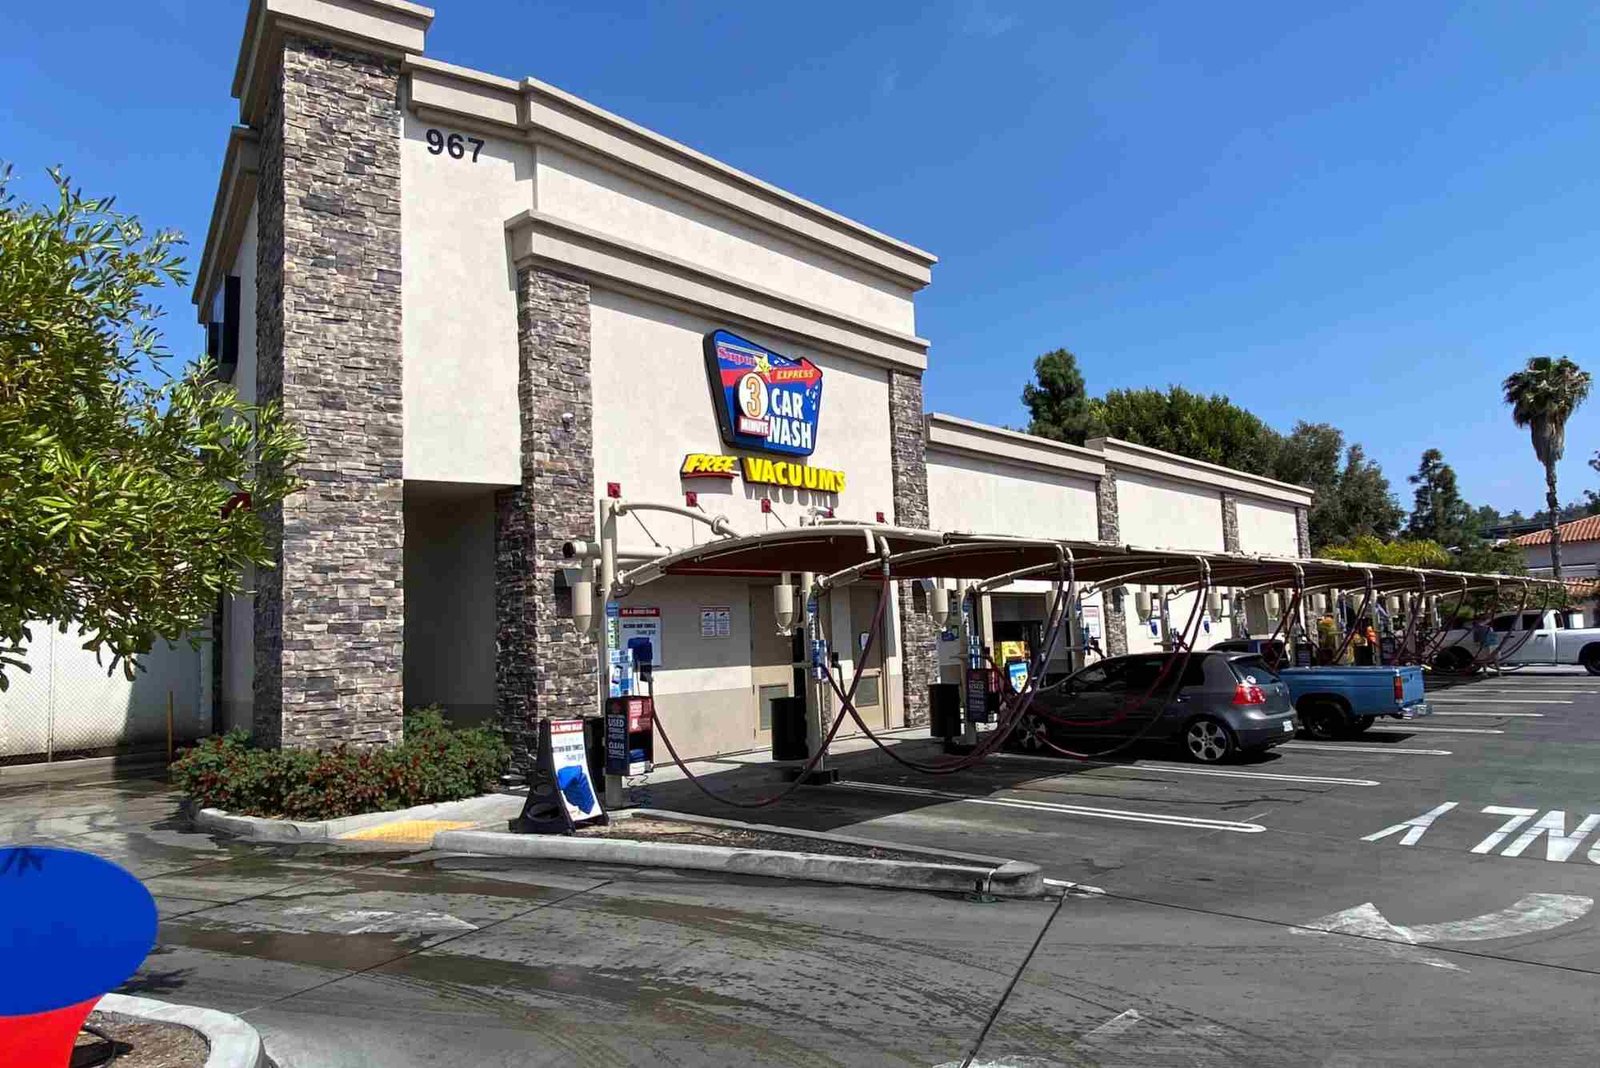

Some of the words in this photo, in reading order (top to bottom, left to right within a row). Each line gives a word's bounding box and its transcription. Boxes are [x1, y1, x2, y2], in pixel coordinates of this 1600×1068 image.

[426, 128, 484, 163] 967
[776, 368, 815, 381] EXPRESS
[746, 376, 762, 417] 3
[771, 387, 804, 420] CAR
[682, 453, 739, 473] FREE
[746, 457, 845, 493] VACUUMS
[1359, 802, 1600, 865] NLY
